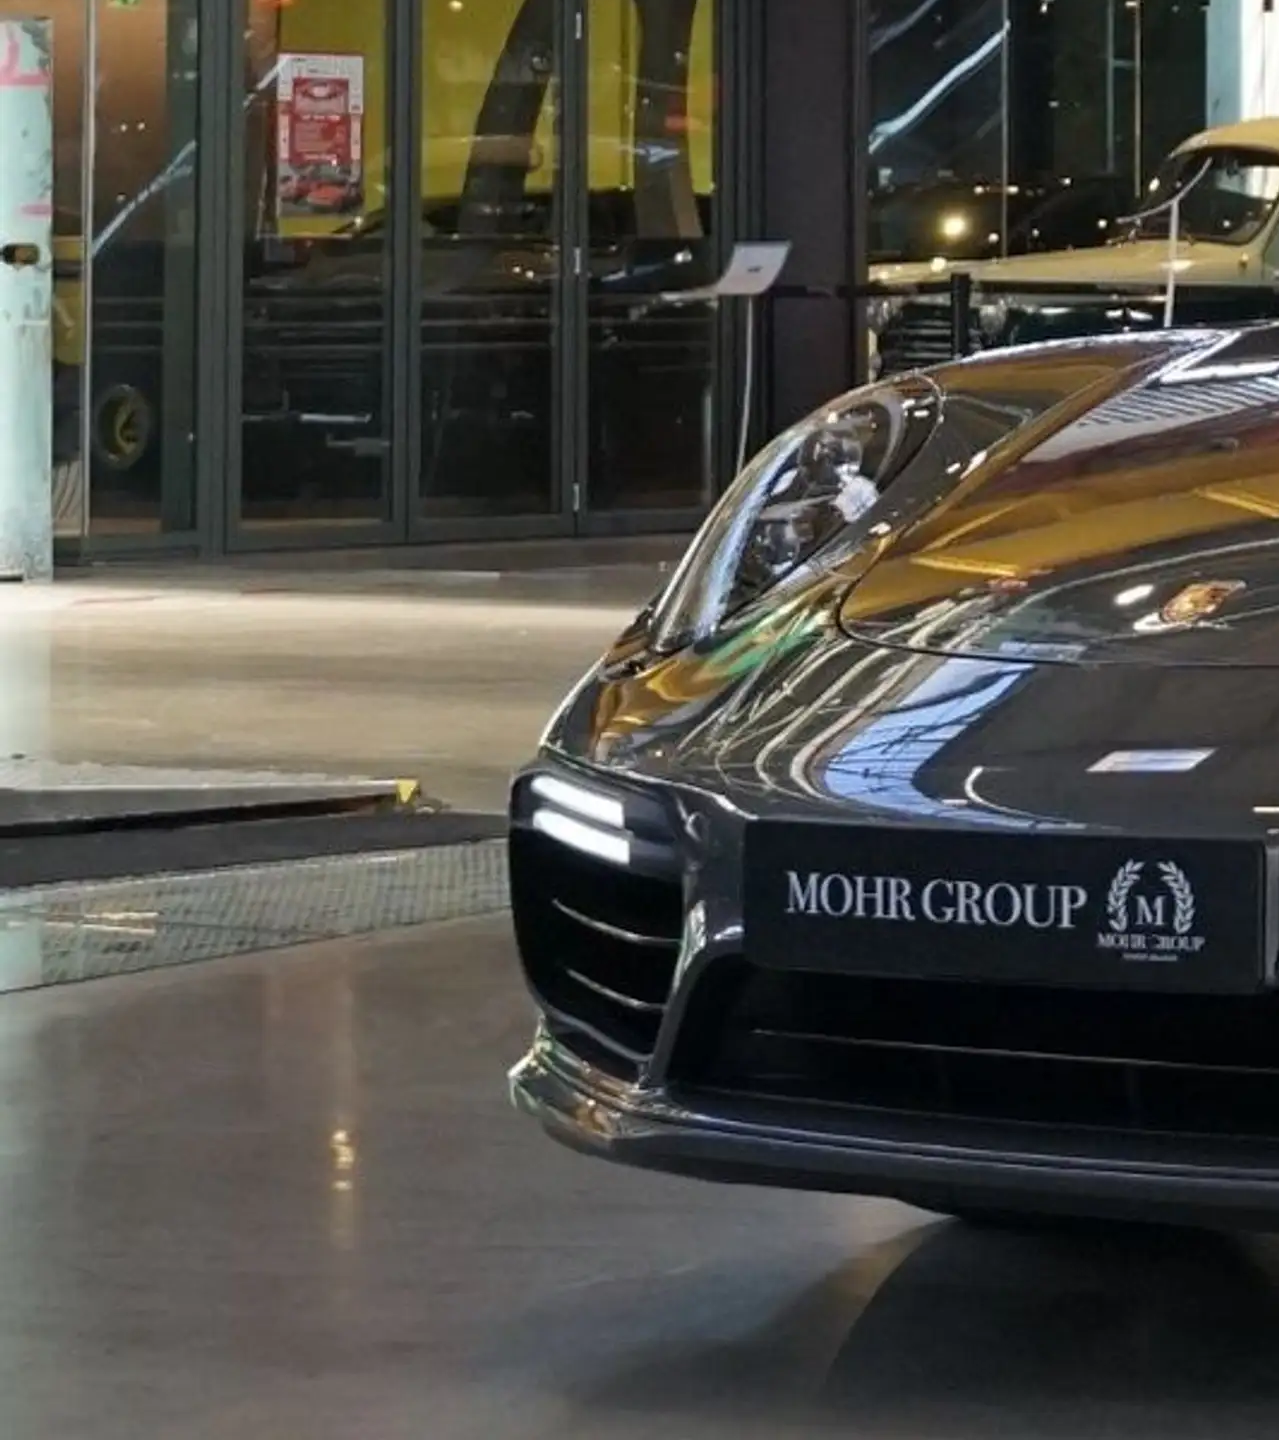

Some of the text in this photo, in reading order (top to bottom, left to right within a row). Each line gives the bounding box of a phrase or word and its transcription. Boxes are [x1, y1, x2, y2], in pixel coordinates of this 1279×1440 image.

[785, 870, 1088, 928] MOHR GROUP
[1135, 895, 1166, 926] M
